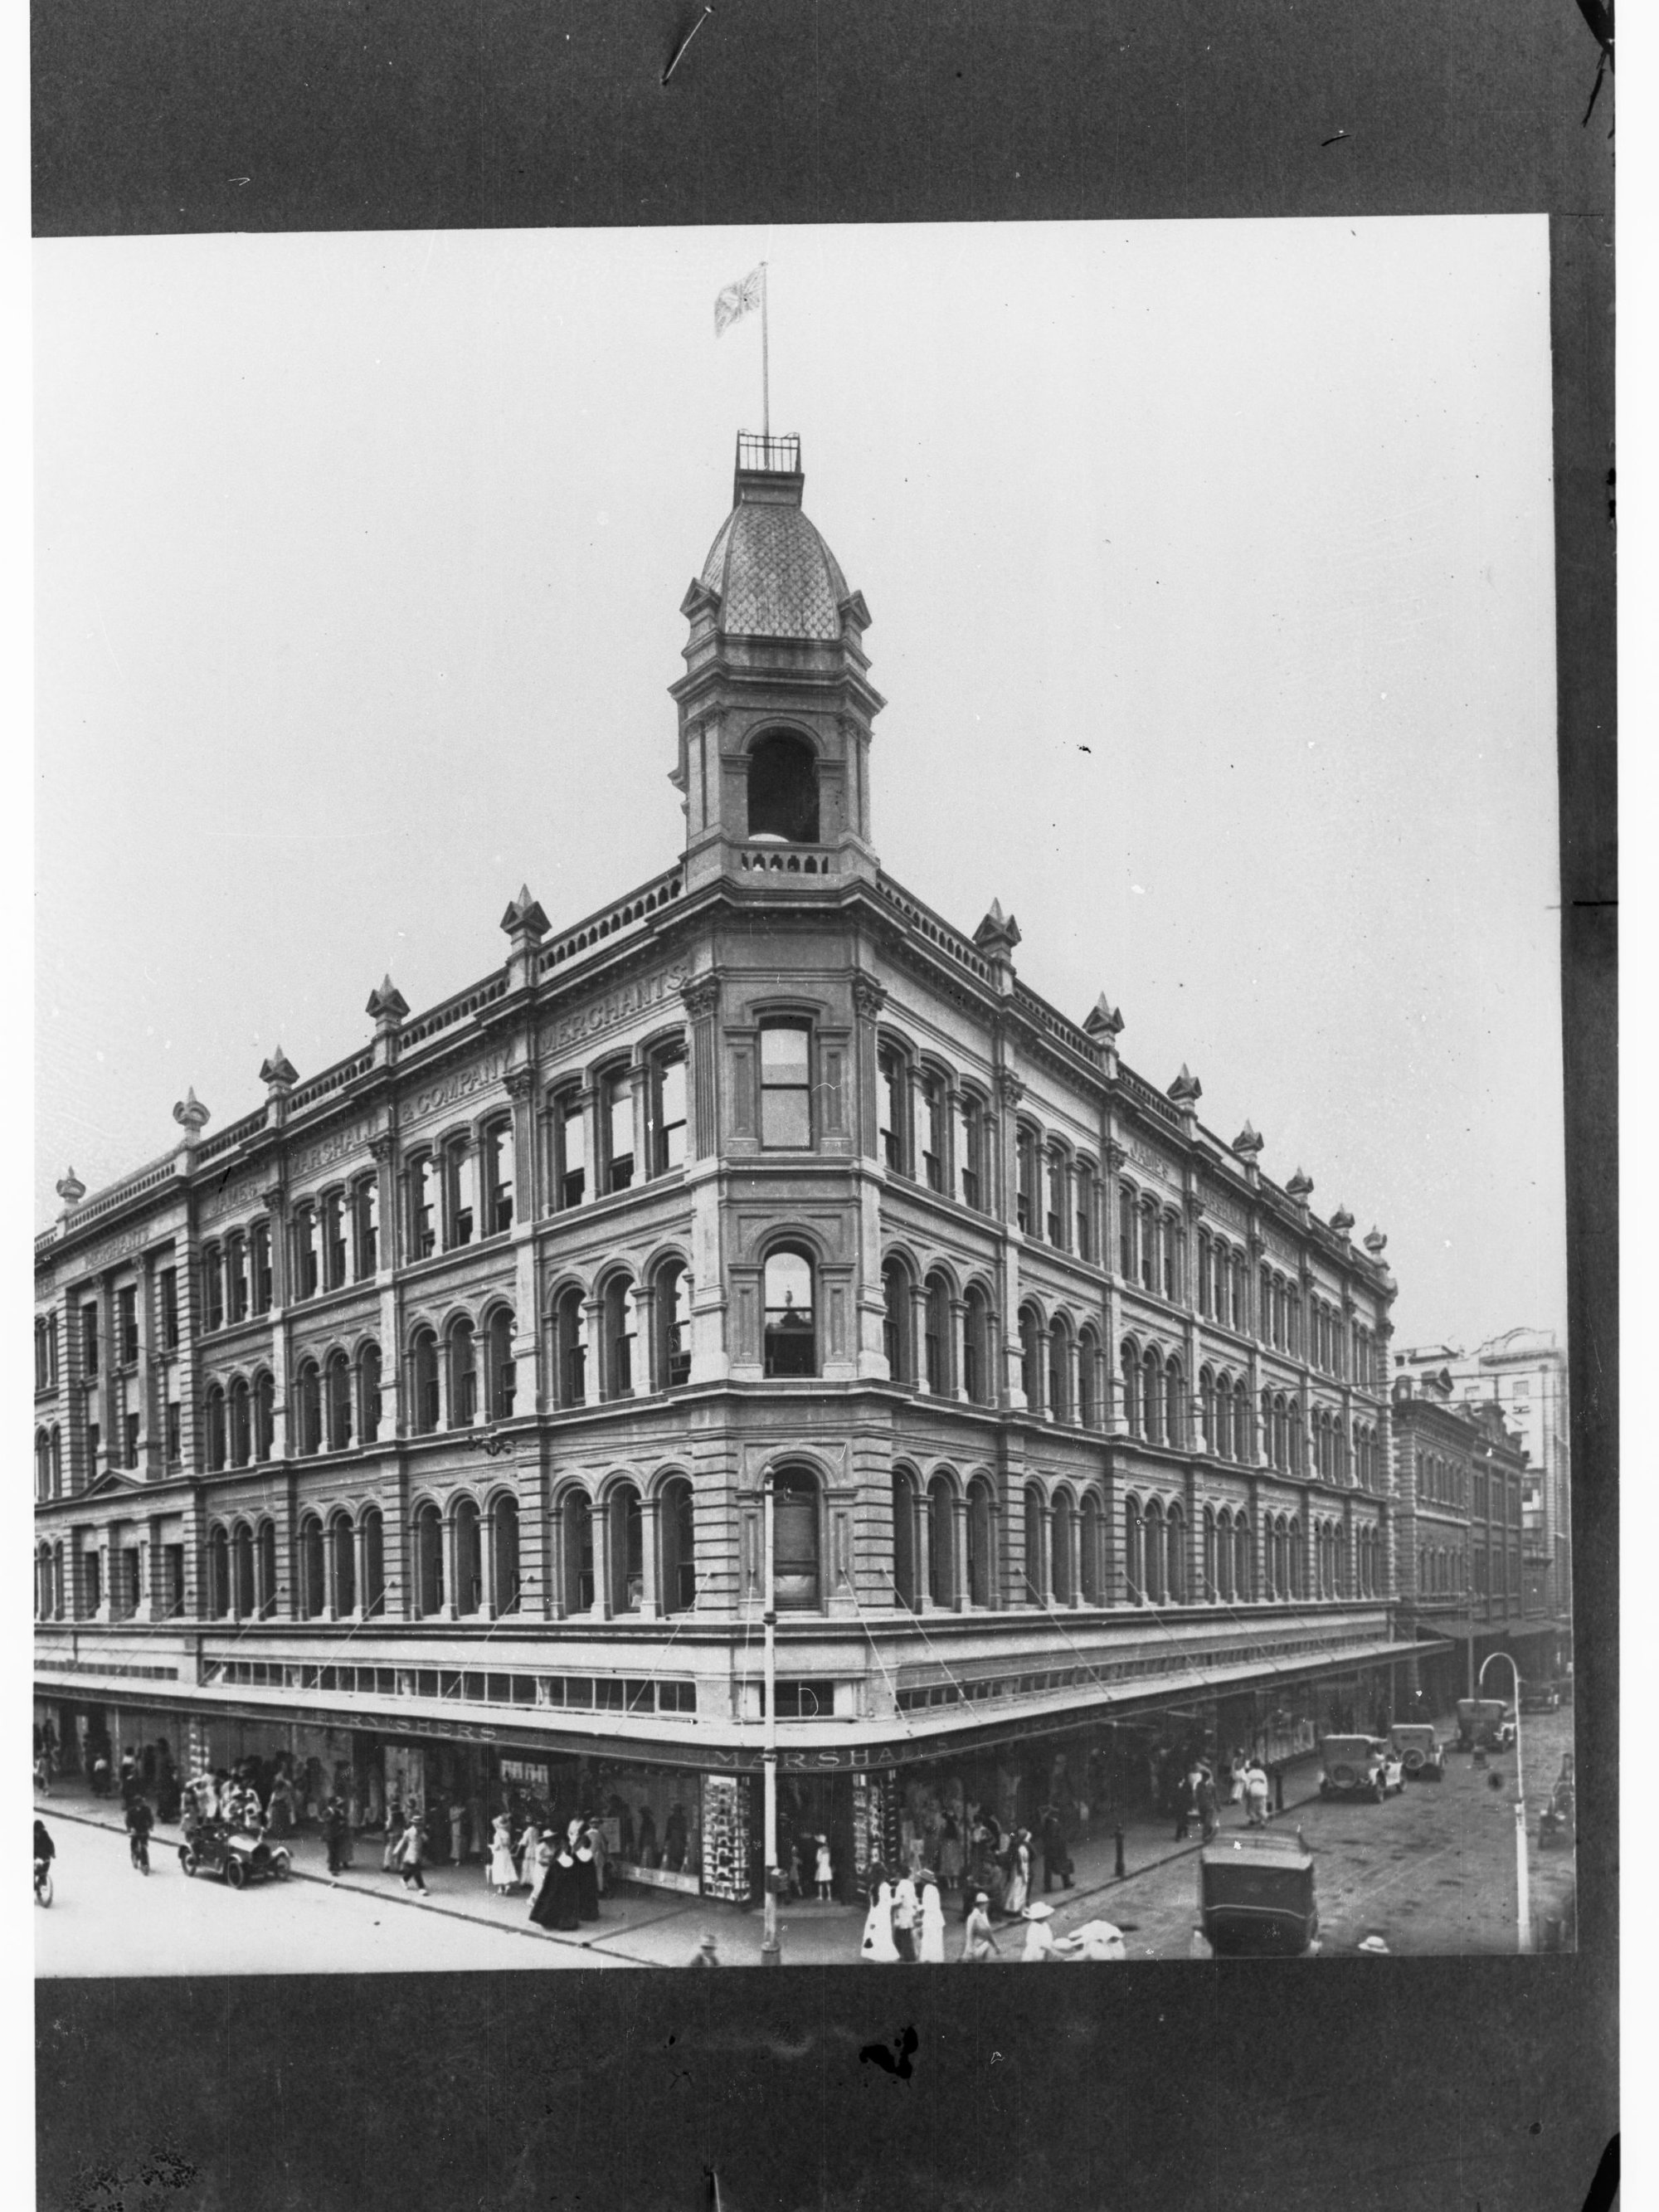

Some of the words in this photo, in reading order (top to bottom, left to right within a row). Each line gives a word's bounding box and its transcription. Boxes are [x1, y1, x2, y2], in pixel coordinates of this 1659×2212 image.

[212, 1182, 258, 1214] JAMES
[289, 1118, 378, 1175] MARSHALL
[402, 1100, 414, 1123] &
[417, 1048, 512, 1114] COMPANY
[540, 965, 688, 1056] MERCHANTS
[1130, 1142, 1170, 1178] JAMES
